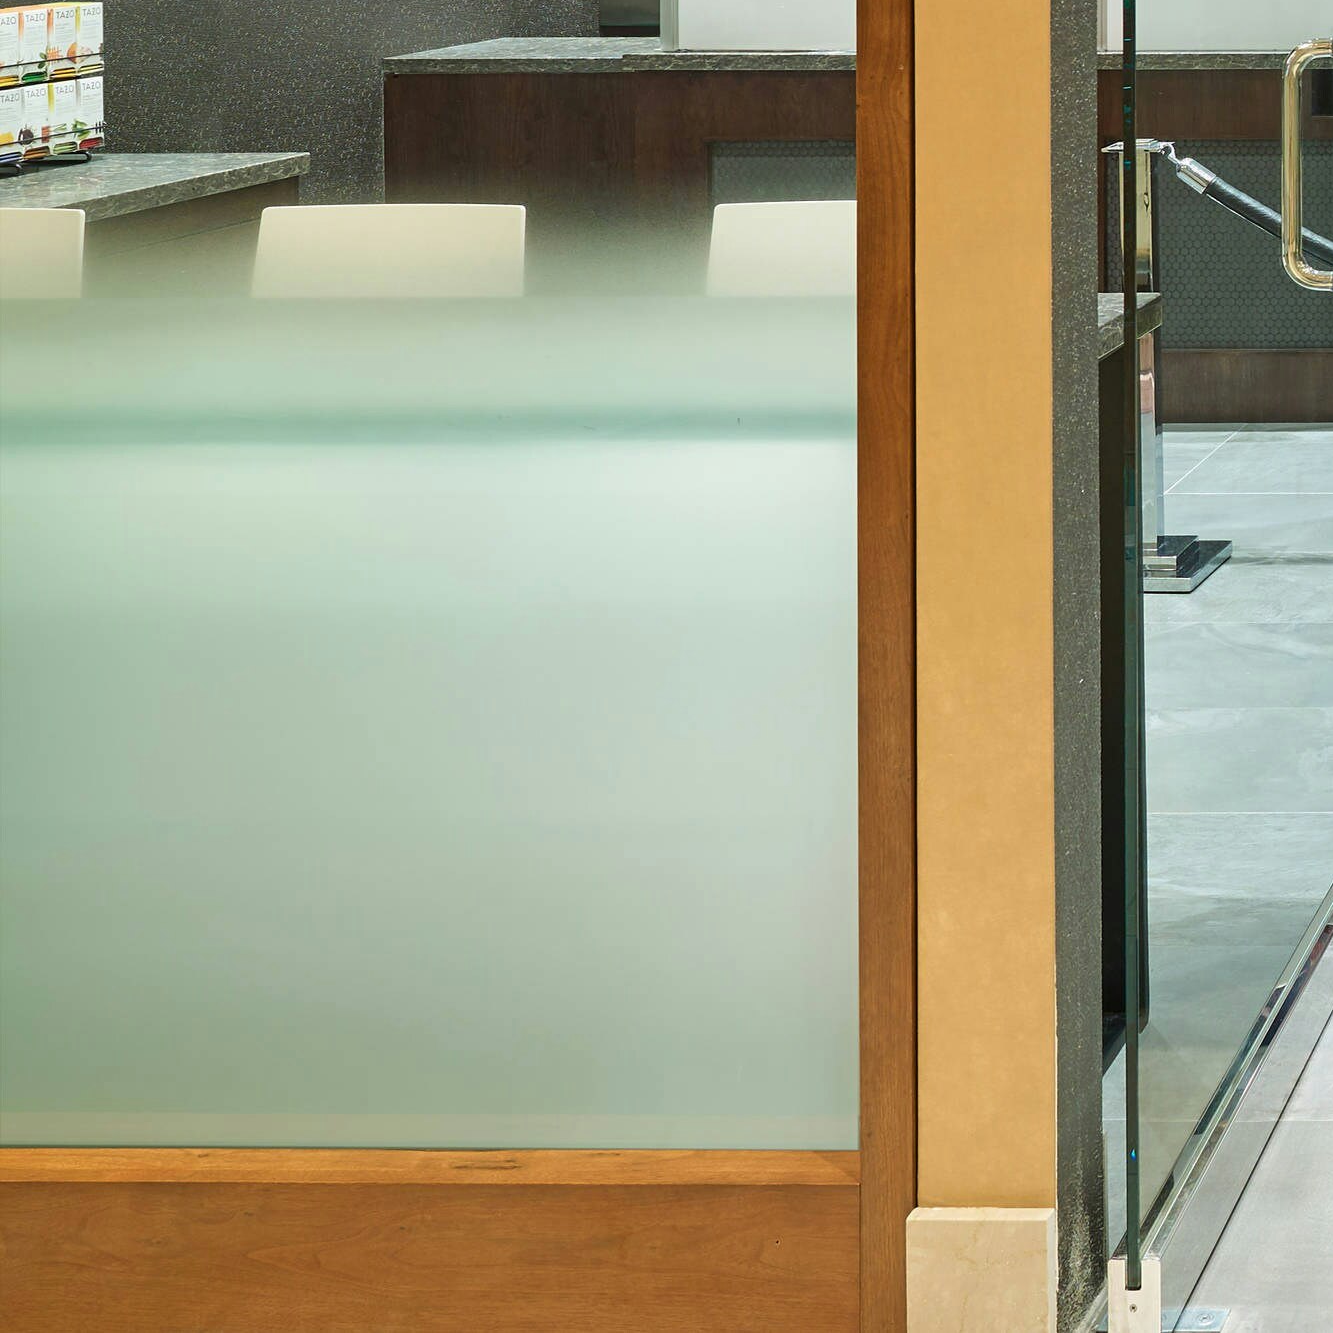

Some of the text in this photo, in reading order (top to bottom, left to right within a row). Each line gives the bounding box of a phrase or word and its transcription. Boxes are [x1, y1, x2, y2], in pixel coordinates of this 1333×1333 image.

[56, 10, 74, 19] TAZO
[83, 7, 101, 16] TAZO
[26, 13, 45, 22] TAZO
[56, 85, 74, 94] TAZO
[82, 81, 101, 90] TAZO
[26, 88, 46, 97] TAZO
